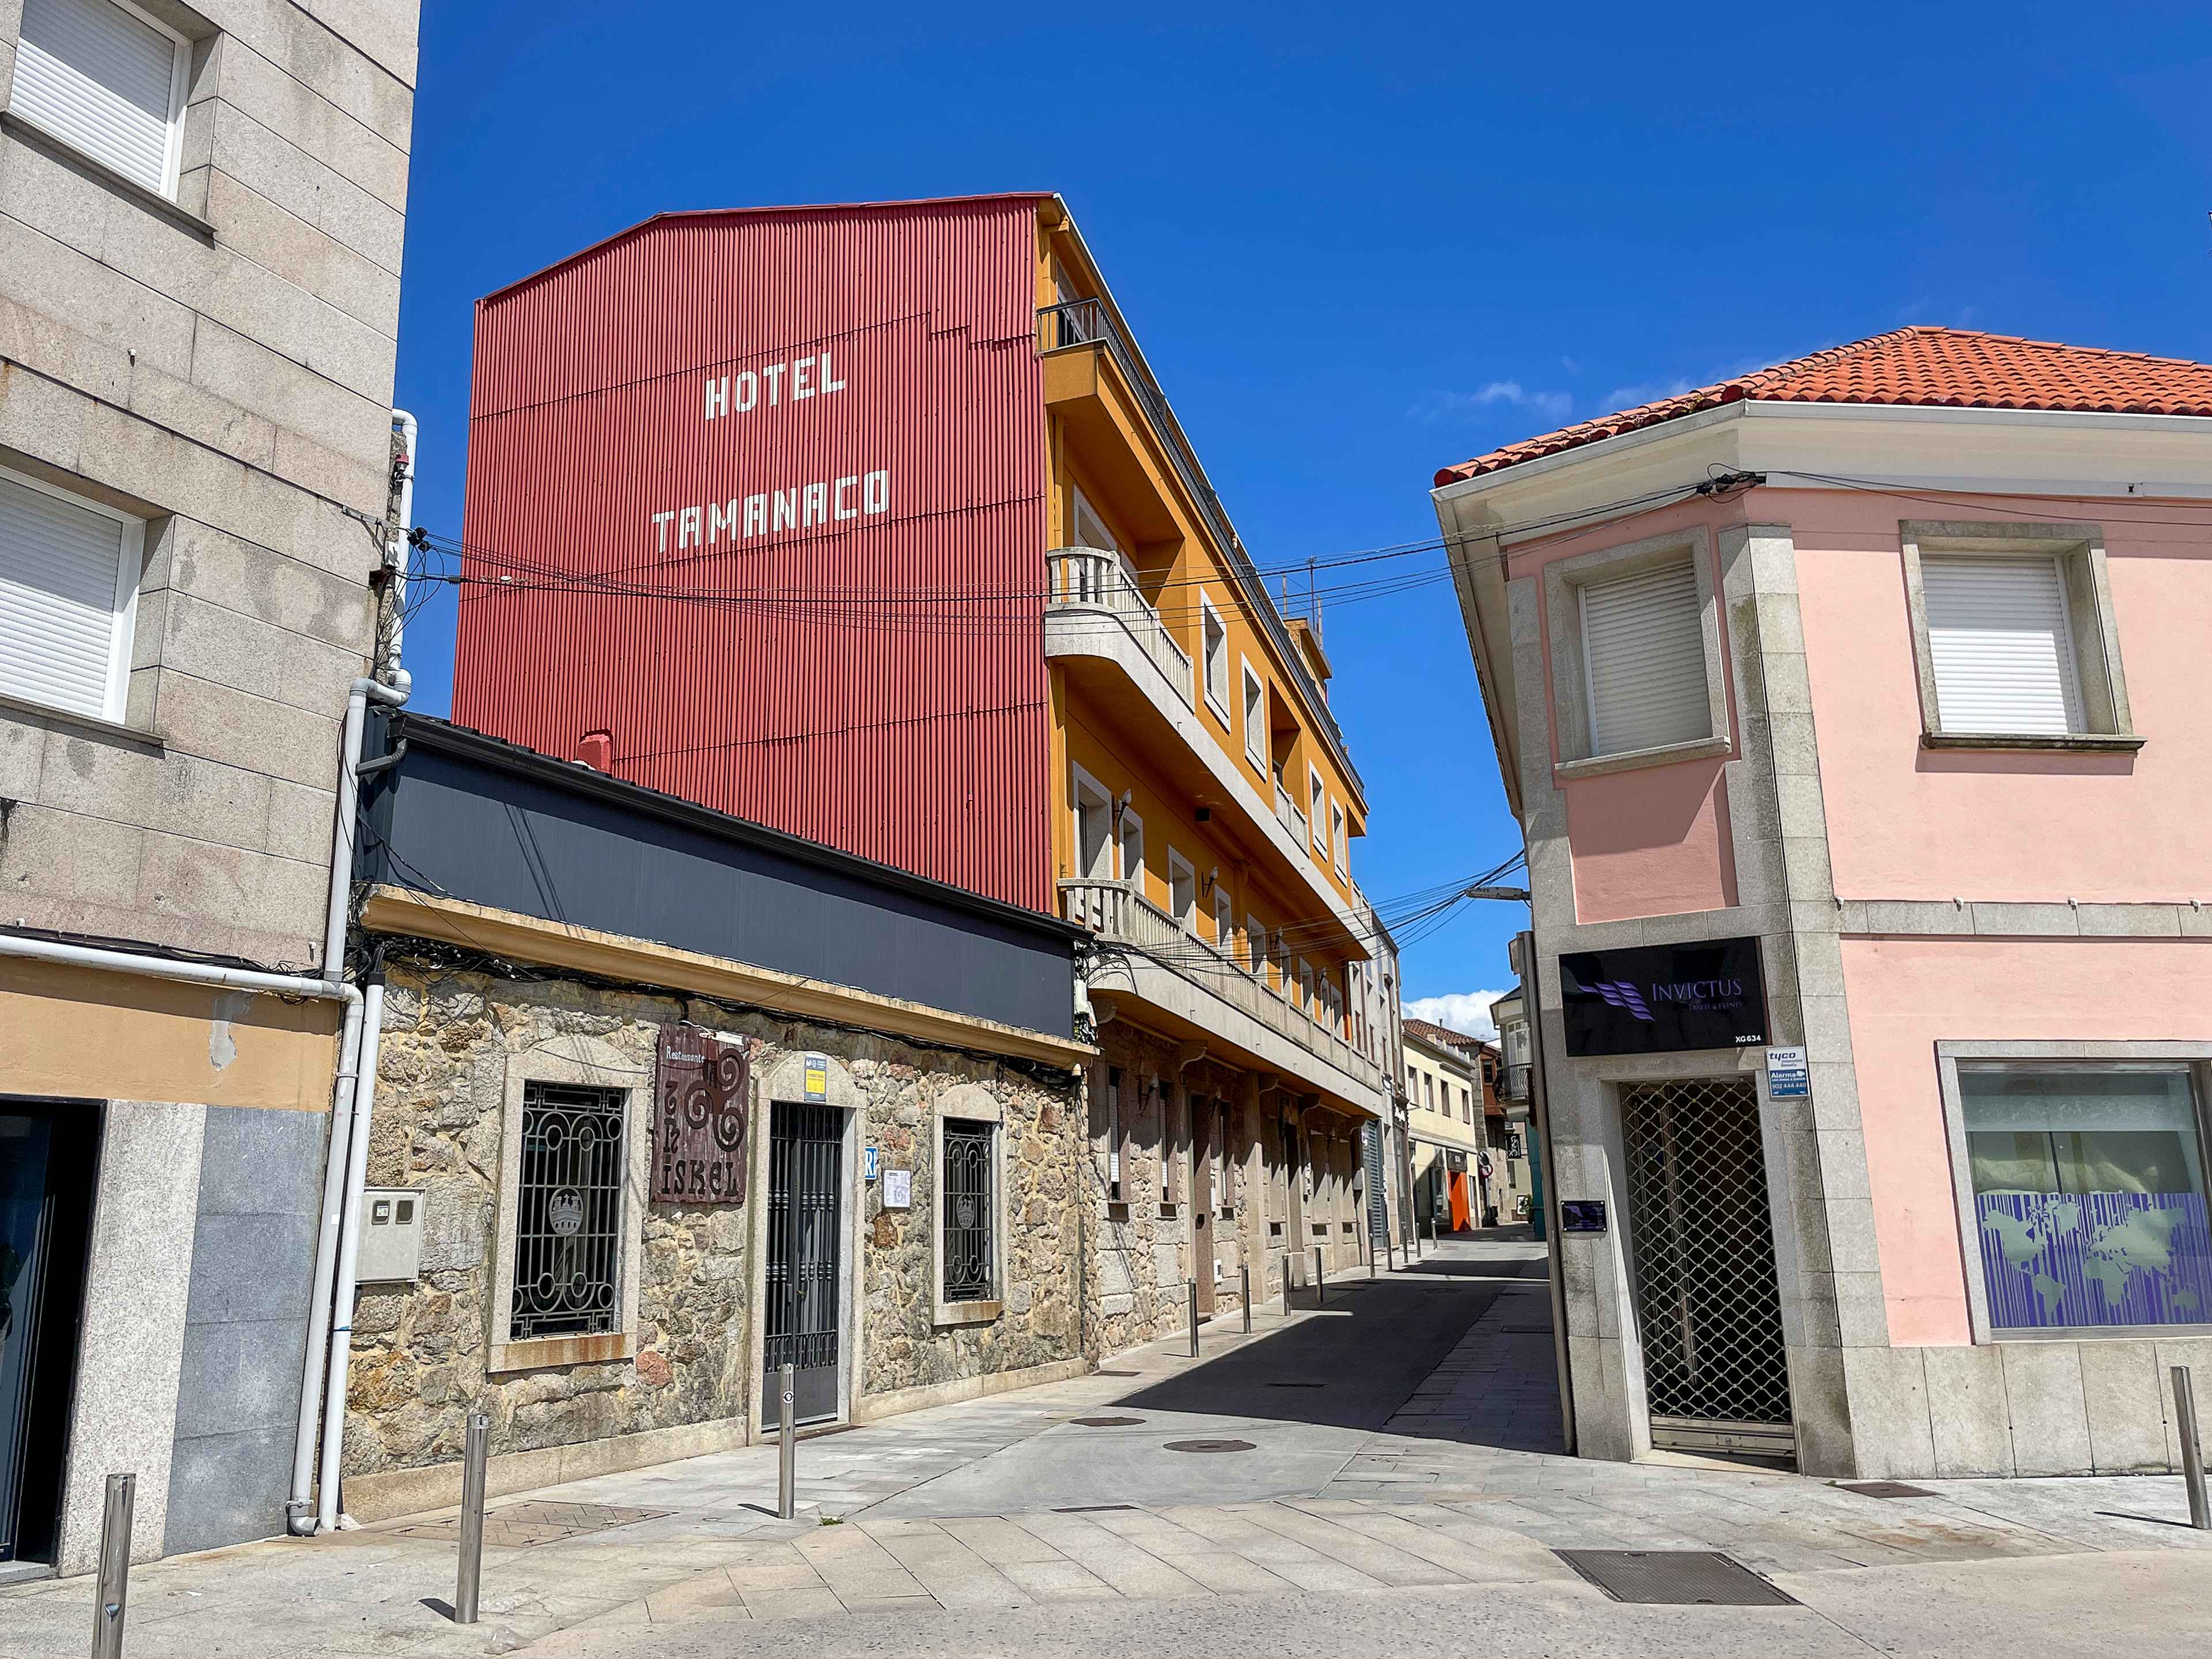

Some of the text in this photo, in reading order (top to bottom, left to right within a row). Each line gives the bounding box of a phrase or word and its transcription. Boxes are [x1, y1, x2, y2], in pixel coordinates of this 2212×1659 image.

[705, 352, 846, 420] HOTEL
[652, 469, 889, 553] TAMANACO
[1652, 979, 1742, 1001] INVICTUS
[666, 1046, 706, 1065] Restaurante
[1769, 1052, 1796, 1060] tyco
